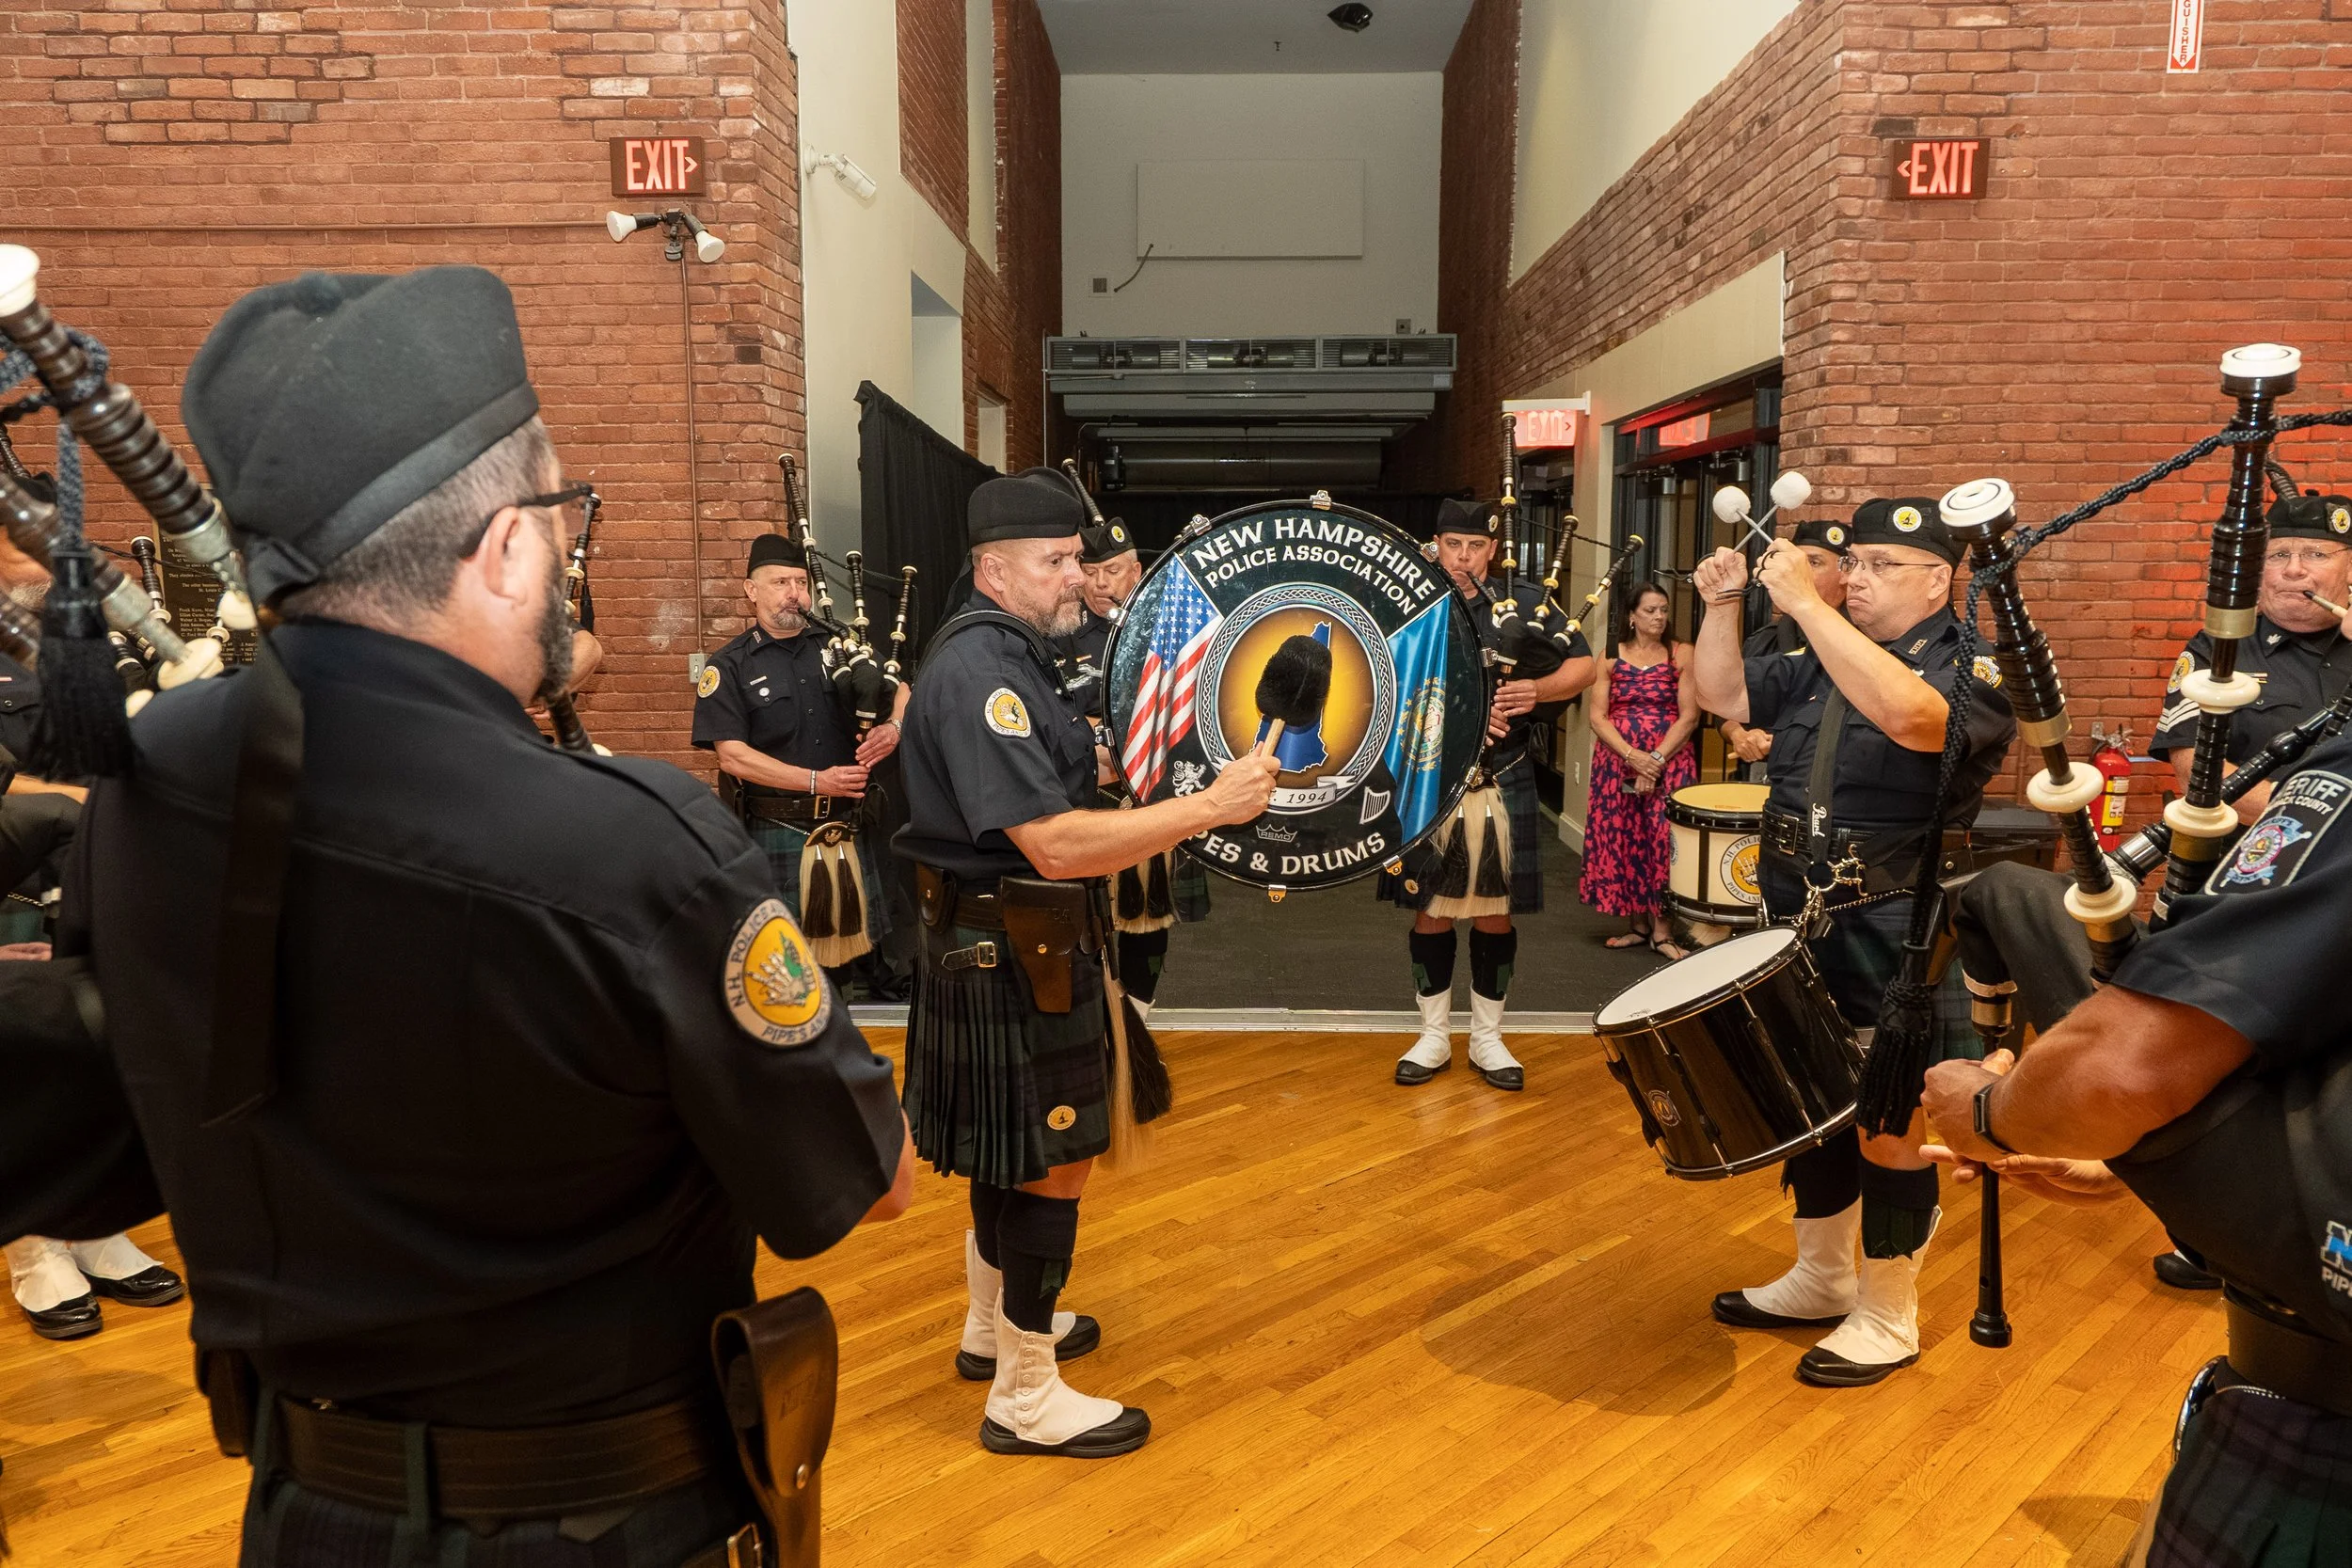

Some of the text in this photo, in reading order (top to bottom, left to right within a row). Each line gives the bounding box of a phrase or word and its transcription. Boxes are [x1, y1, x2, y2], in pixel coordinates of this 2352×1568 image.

[625, 140, 690, 191] EXIT
[1909, 142, 1979, 195] EXIT
[1527, 411, 1565, 442] EXIT
[1192, 518, 1437, 600] NEW HAMPSHIRE
[1204, 546, 1417, 615] POLICE ASSOCIATION
[1287, 791, 1327, 803] 1994
[2295, 796, 2333, 815] COUNTY
[1261, 831, 1292, 840] REMO
[1812, 803, 1827, 837] Pearl
[1250, 852, 1269, 873] &
[1280, 832, 1386, 875] DRUMS
[1727, 881, 1745, 898] PIPES
[731, 907, 771, 963] POLICE
[761, 1025, 807, 1041] PIPES
